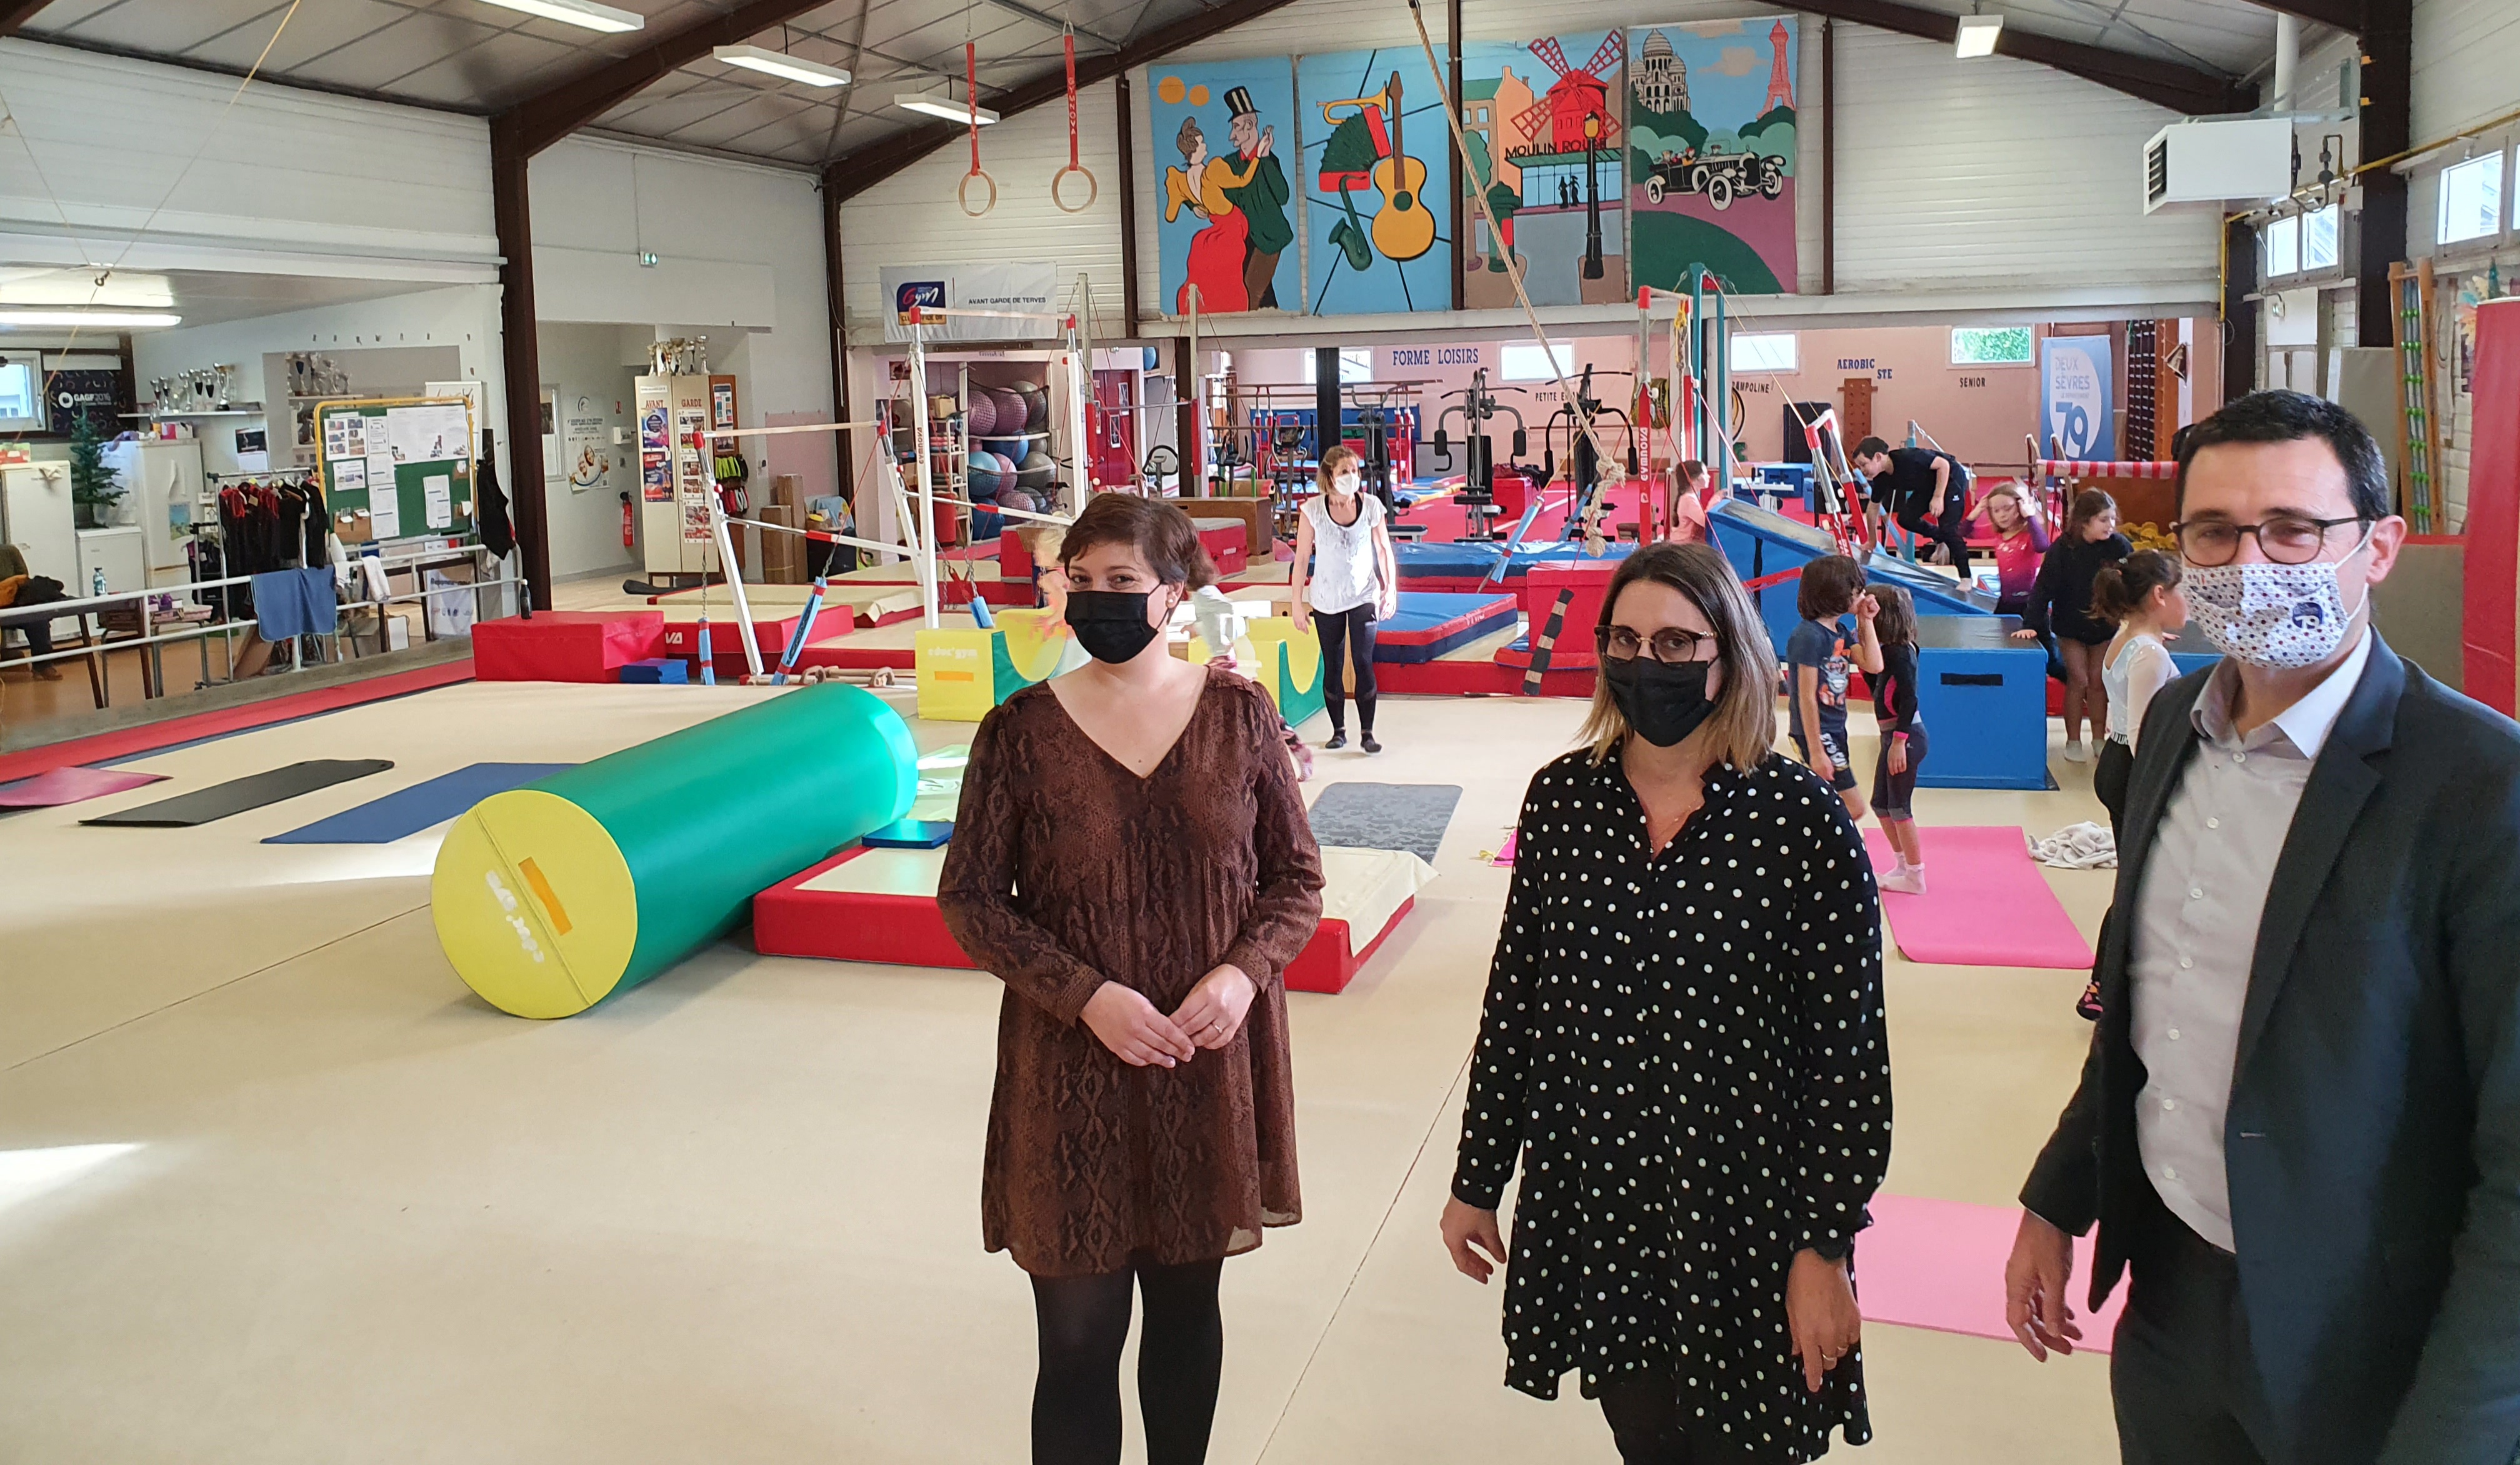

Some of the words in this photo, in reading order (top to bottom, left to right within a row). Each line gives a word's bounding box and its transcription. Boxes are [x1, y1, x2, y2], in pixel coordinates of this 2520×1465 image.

[1068, 77, 1076, 134] GYMNOVA
[1504, 141, 1557, 159] MOULIN
[1392, 350, 1430, 366] FORME
[1438, 348, 1479, 364] LOISIRS
[1837, 359, 1875, 370] AEROBIC
[2055, 356, 2079, 371] DEUX
[1877, 369, 1892, 379] STE
[2056, 372, 2091, 390] SÈVRES
[1959, 377, 1986, 388] SENIOR
[646, 399, 664, 408] AVANT
[681, 399, 702, 408] GARDE
[1535, 392, 1558, 402] PETITE
[2056, 402, 2089, 460] 79
[1640, 427, 1649, 481] GYMNOVA
